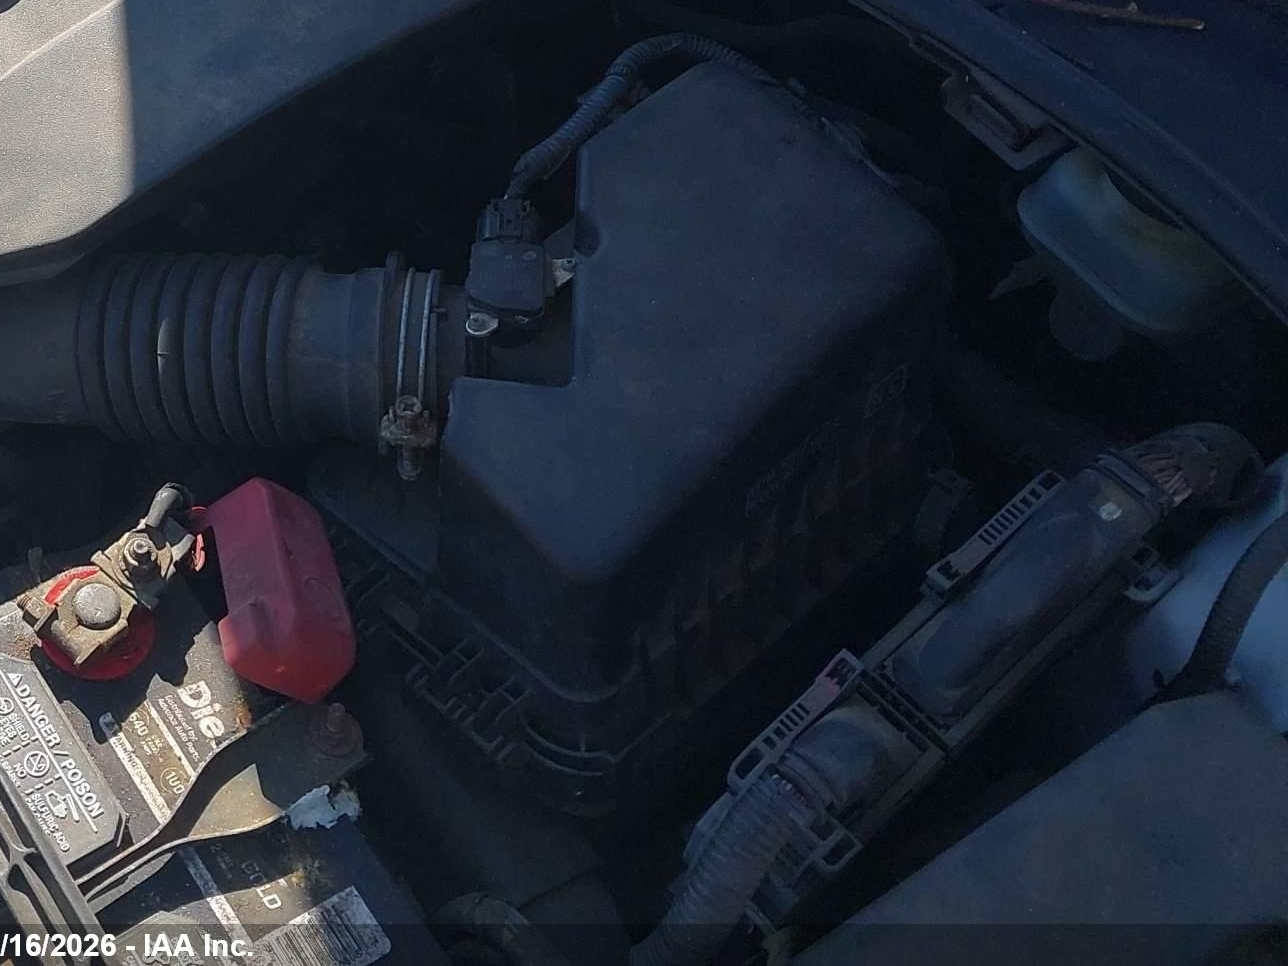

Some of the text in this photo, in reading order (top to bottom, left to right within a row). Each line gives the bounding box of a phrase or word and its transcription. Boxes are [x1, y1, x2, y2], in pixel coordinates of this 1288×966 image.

[0, 716, 17, 739] EYES
[7, 711, 30, 741] SHIELD
[174, 724, 189, 742] Auto
[13, 682, 63, 750] DANGER
[58, 756, 106, 820] POISON
[12, 761, 28, 779] NO
[28, 788, 72, 853] SULFURIC ACID
[239, 857, 284, 912] GOLD
